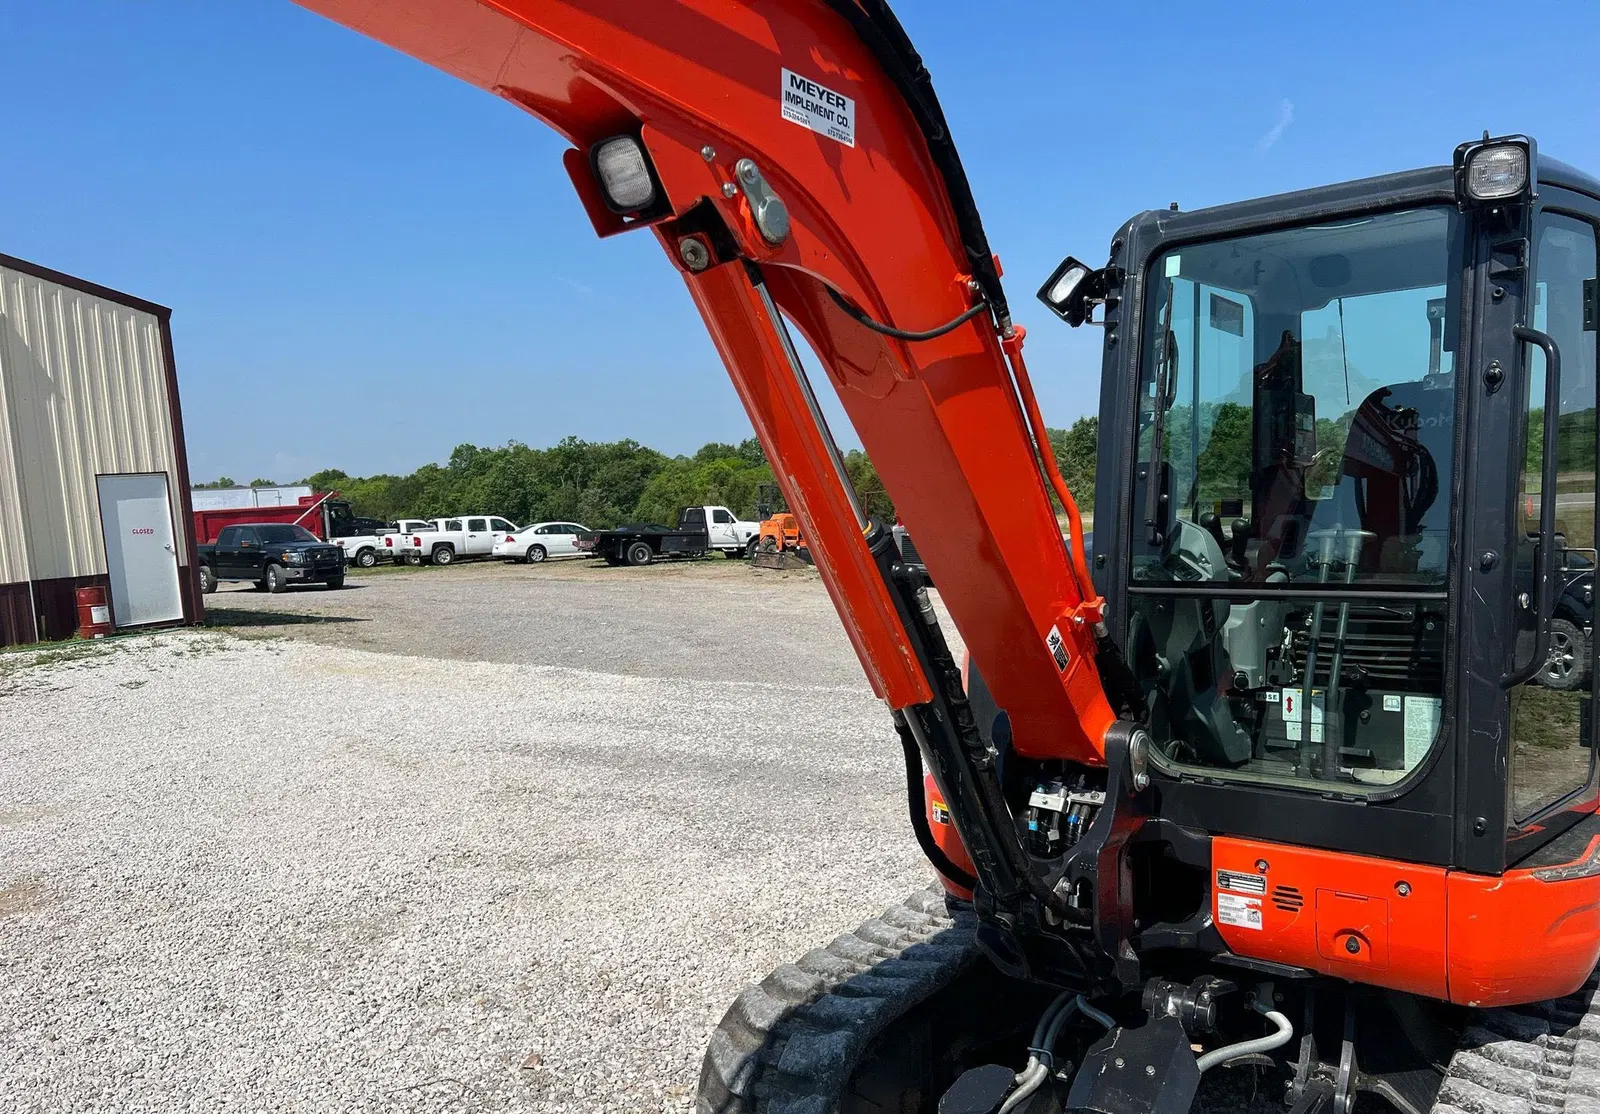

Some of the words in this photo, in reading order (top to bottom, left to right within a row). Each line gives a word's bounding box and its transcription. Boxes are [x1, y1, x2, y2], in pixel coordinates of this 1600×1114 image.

[785, 90, 835, 121] IMPLEMENT
[836, 114, 850, 129] CO.
[790, 73, 846, 111] MEYER
[1257, 693, 1278, 701] FUSE
